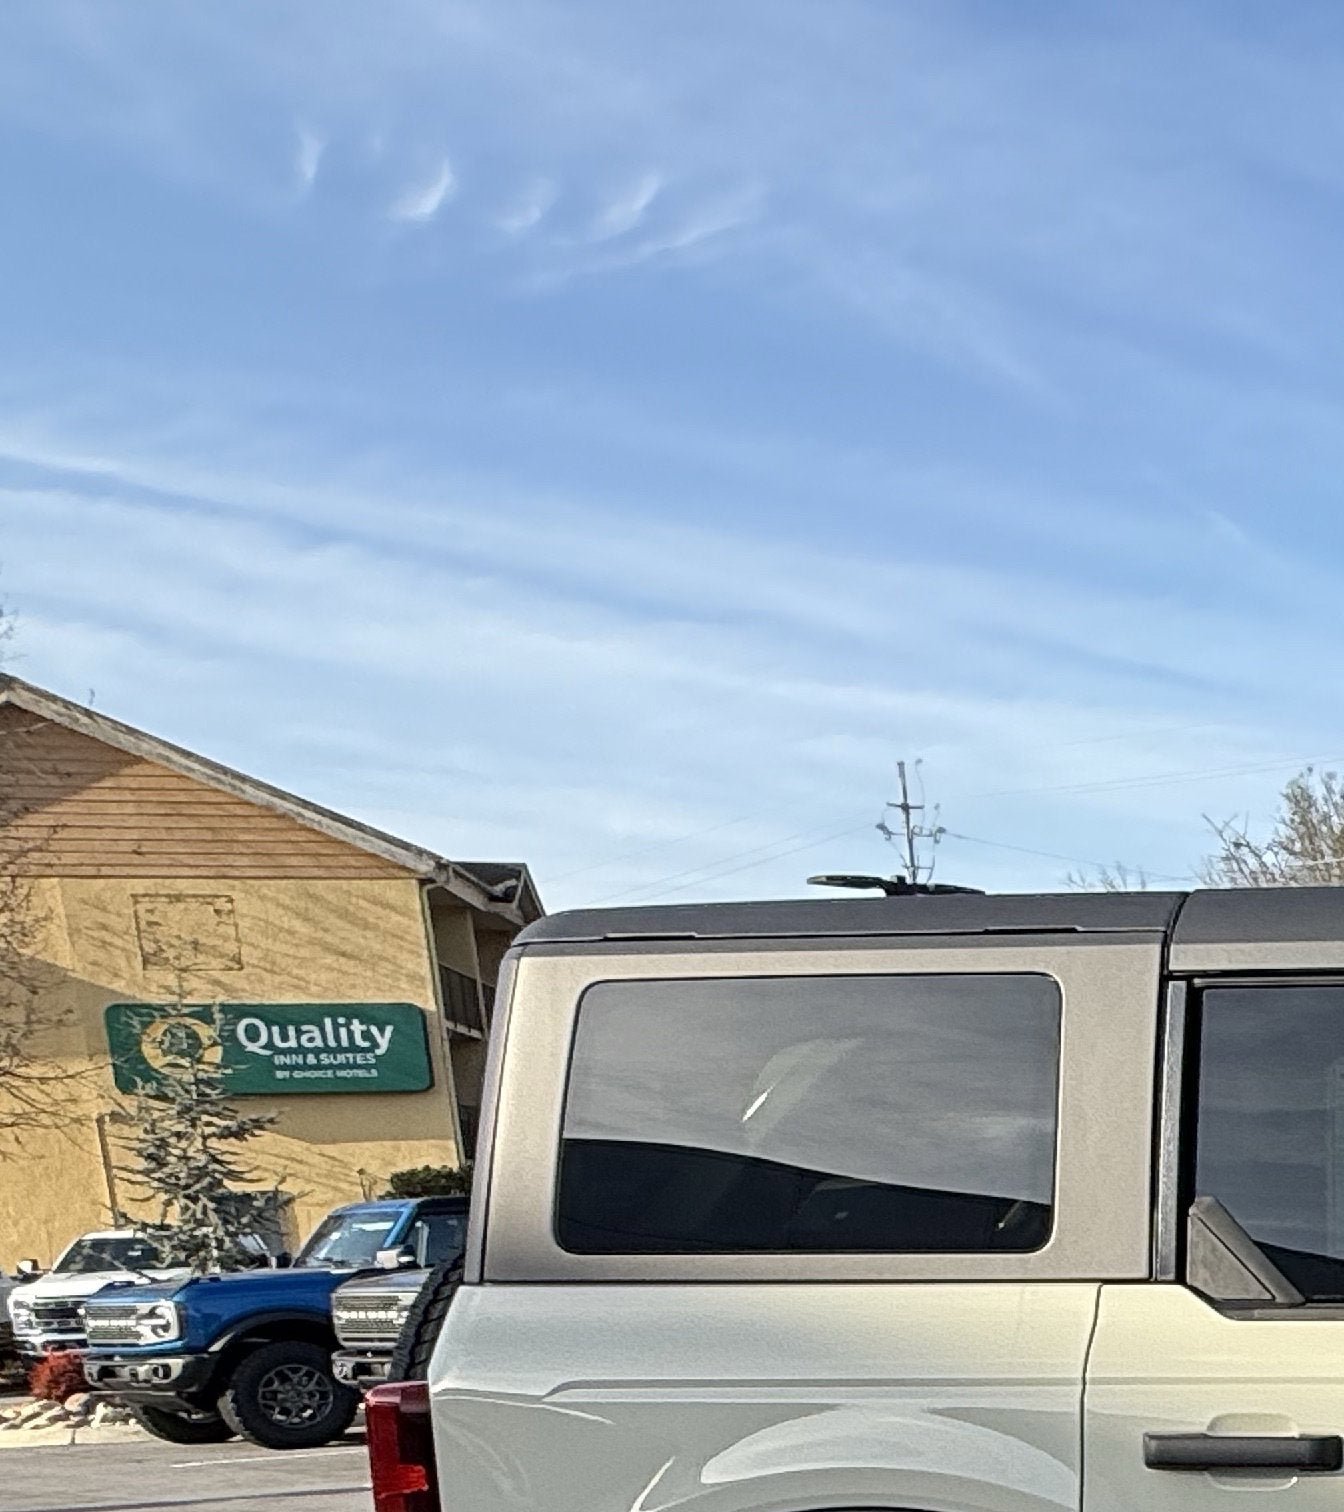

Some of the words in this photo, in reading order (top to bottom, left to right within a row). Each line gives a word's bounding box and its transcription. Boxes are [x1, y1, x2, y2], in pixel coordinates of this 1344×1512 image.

[236, 1017, 394, 1056] Quality
[273, 1054, 303, 1066] INN
[306, 1053, 318, 1065] &
[319, 1052, 376, 1065] SUITES
